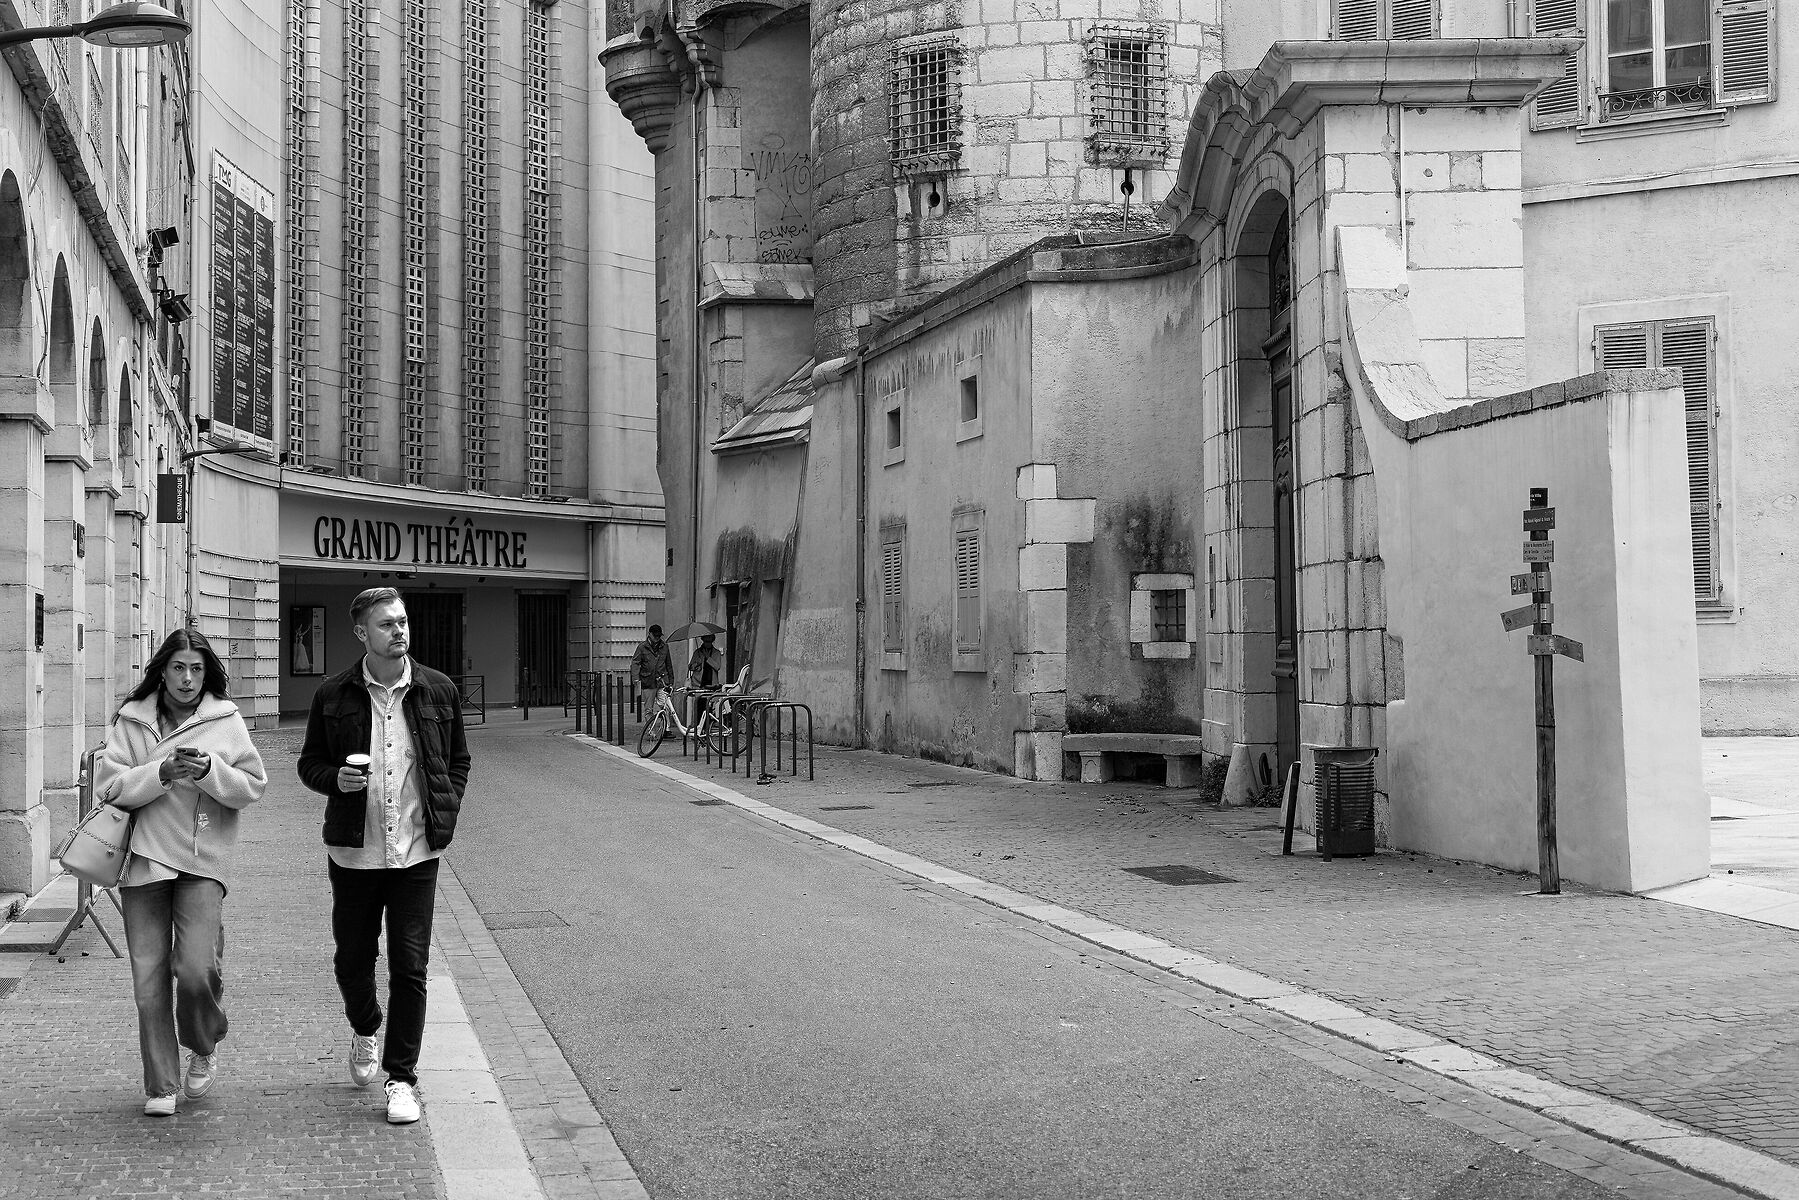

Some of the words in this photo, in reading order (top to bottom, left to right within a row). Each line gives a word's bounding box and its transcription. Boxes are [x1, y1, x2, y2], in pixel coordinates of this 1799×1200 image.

[218, 164, 232, 188] TMG
[313, 515, 401, 561] GRAND
[407, 516, 527, 568] THÉÂTRE
